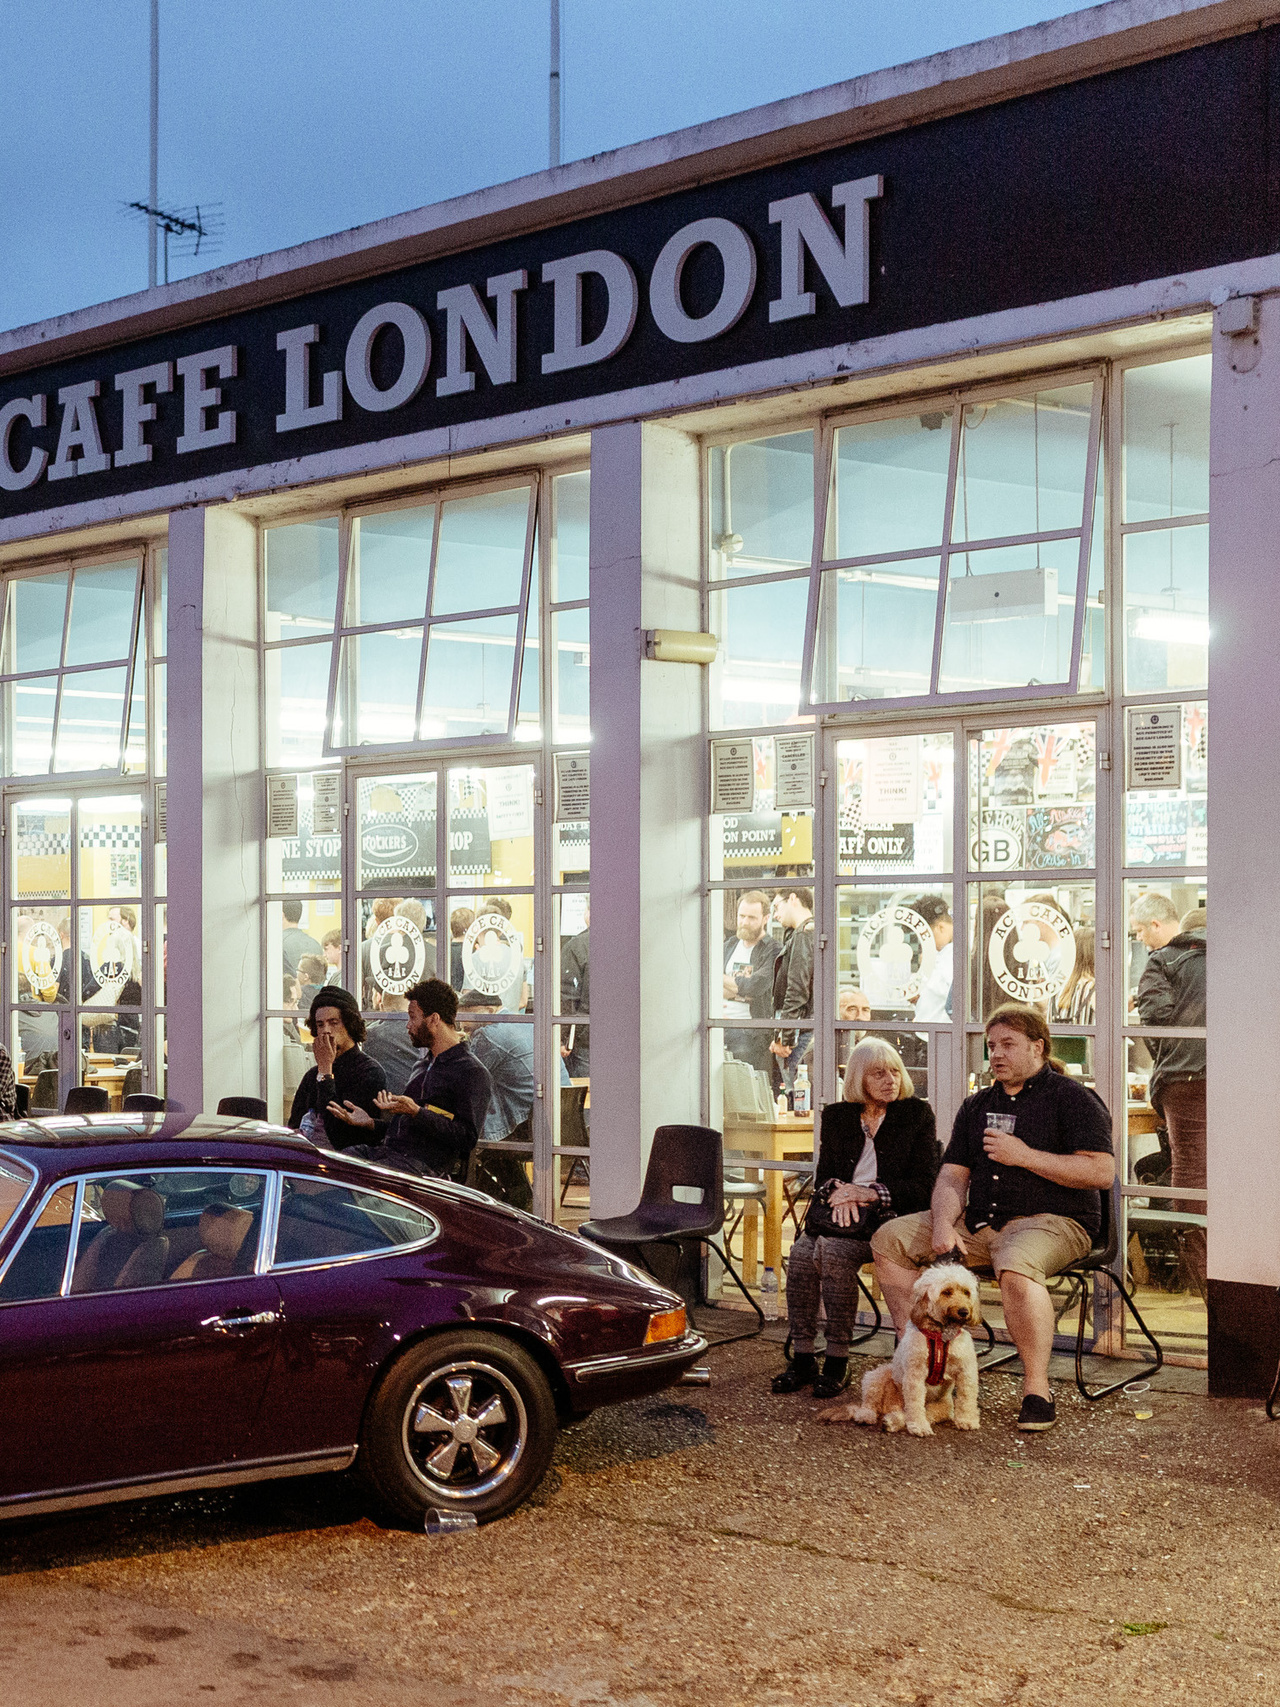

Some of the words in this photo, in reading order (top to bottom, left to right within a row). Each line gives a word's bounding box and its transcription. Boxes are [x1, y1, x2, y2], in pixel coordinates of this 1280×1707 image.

[276, 174, 884, 432] LONDON
[362, 833, 407, 850] ROCKERS
[741, 829, 776, 842] POINT
[867, 837, 905, 854] ONLY
[305, 838, 342, 858] STOP
[971, 839, 1010, 863] GB
[374, 920, 392, 945] ACE
[395, 918, 422, 946] CAFE
[467, 917, 486, 945] ACE
[894, 908, 932, 941] CAFE
[1029, 904, 1071, 940] CAFE
[375, 970, 421, 994] LONDON
[468, 970, 517, 994] LONDON
[997, 970, 1067, 1000] LONDON
